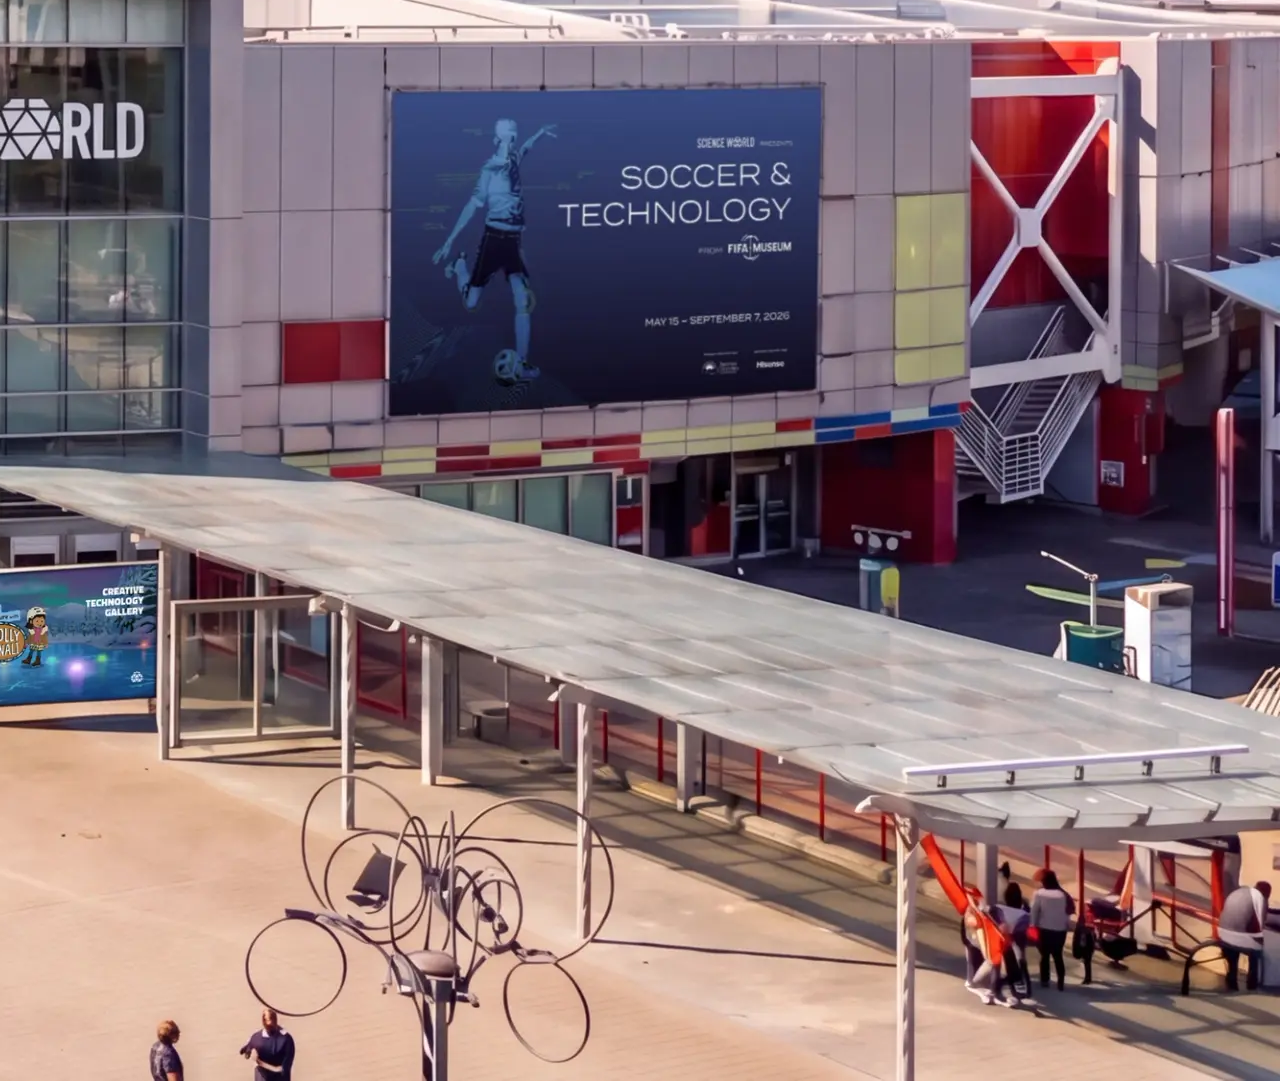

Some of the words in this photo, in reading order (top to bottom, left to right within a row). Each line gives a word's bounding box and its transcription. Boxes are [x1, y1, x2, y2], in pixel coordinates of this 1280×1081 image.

[696, 137, 725, 149] SCIENCE
[726, 136, 755, 148] WORLD
[621, 163, 760, 190] SOCCER
[770, 161, 792, 186] &
[558, 197, 792, 228] TECHNOLOGY
[727, 243, 748, 254] FIFA
[752, 241, 792, 253] MUSEUM
[644, 318, 667, 327] MAY
[669, 316, 680, 326] 15
[689, 313, 752, 325] SEPTEMBER
[754, 312, 762, 323] 7,
[763, 311, 791, 322] 2026
[756, 360, 785, 368] Hisense
[102, 586, 144, 596] CREATIVE
[85, 597, 144, 607] TECHNOLOGY
[104, 607, 144, 617] GALLERY
